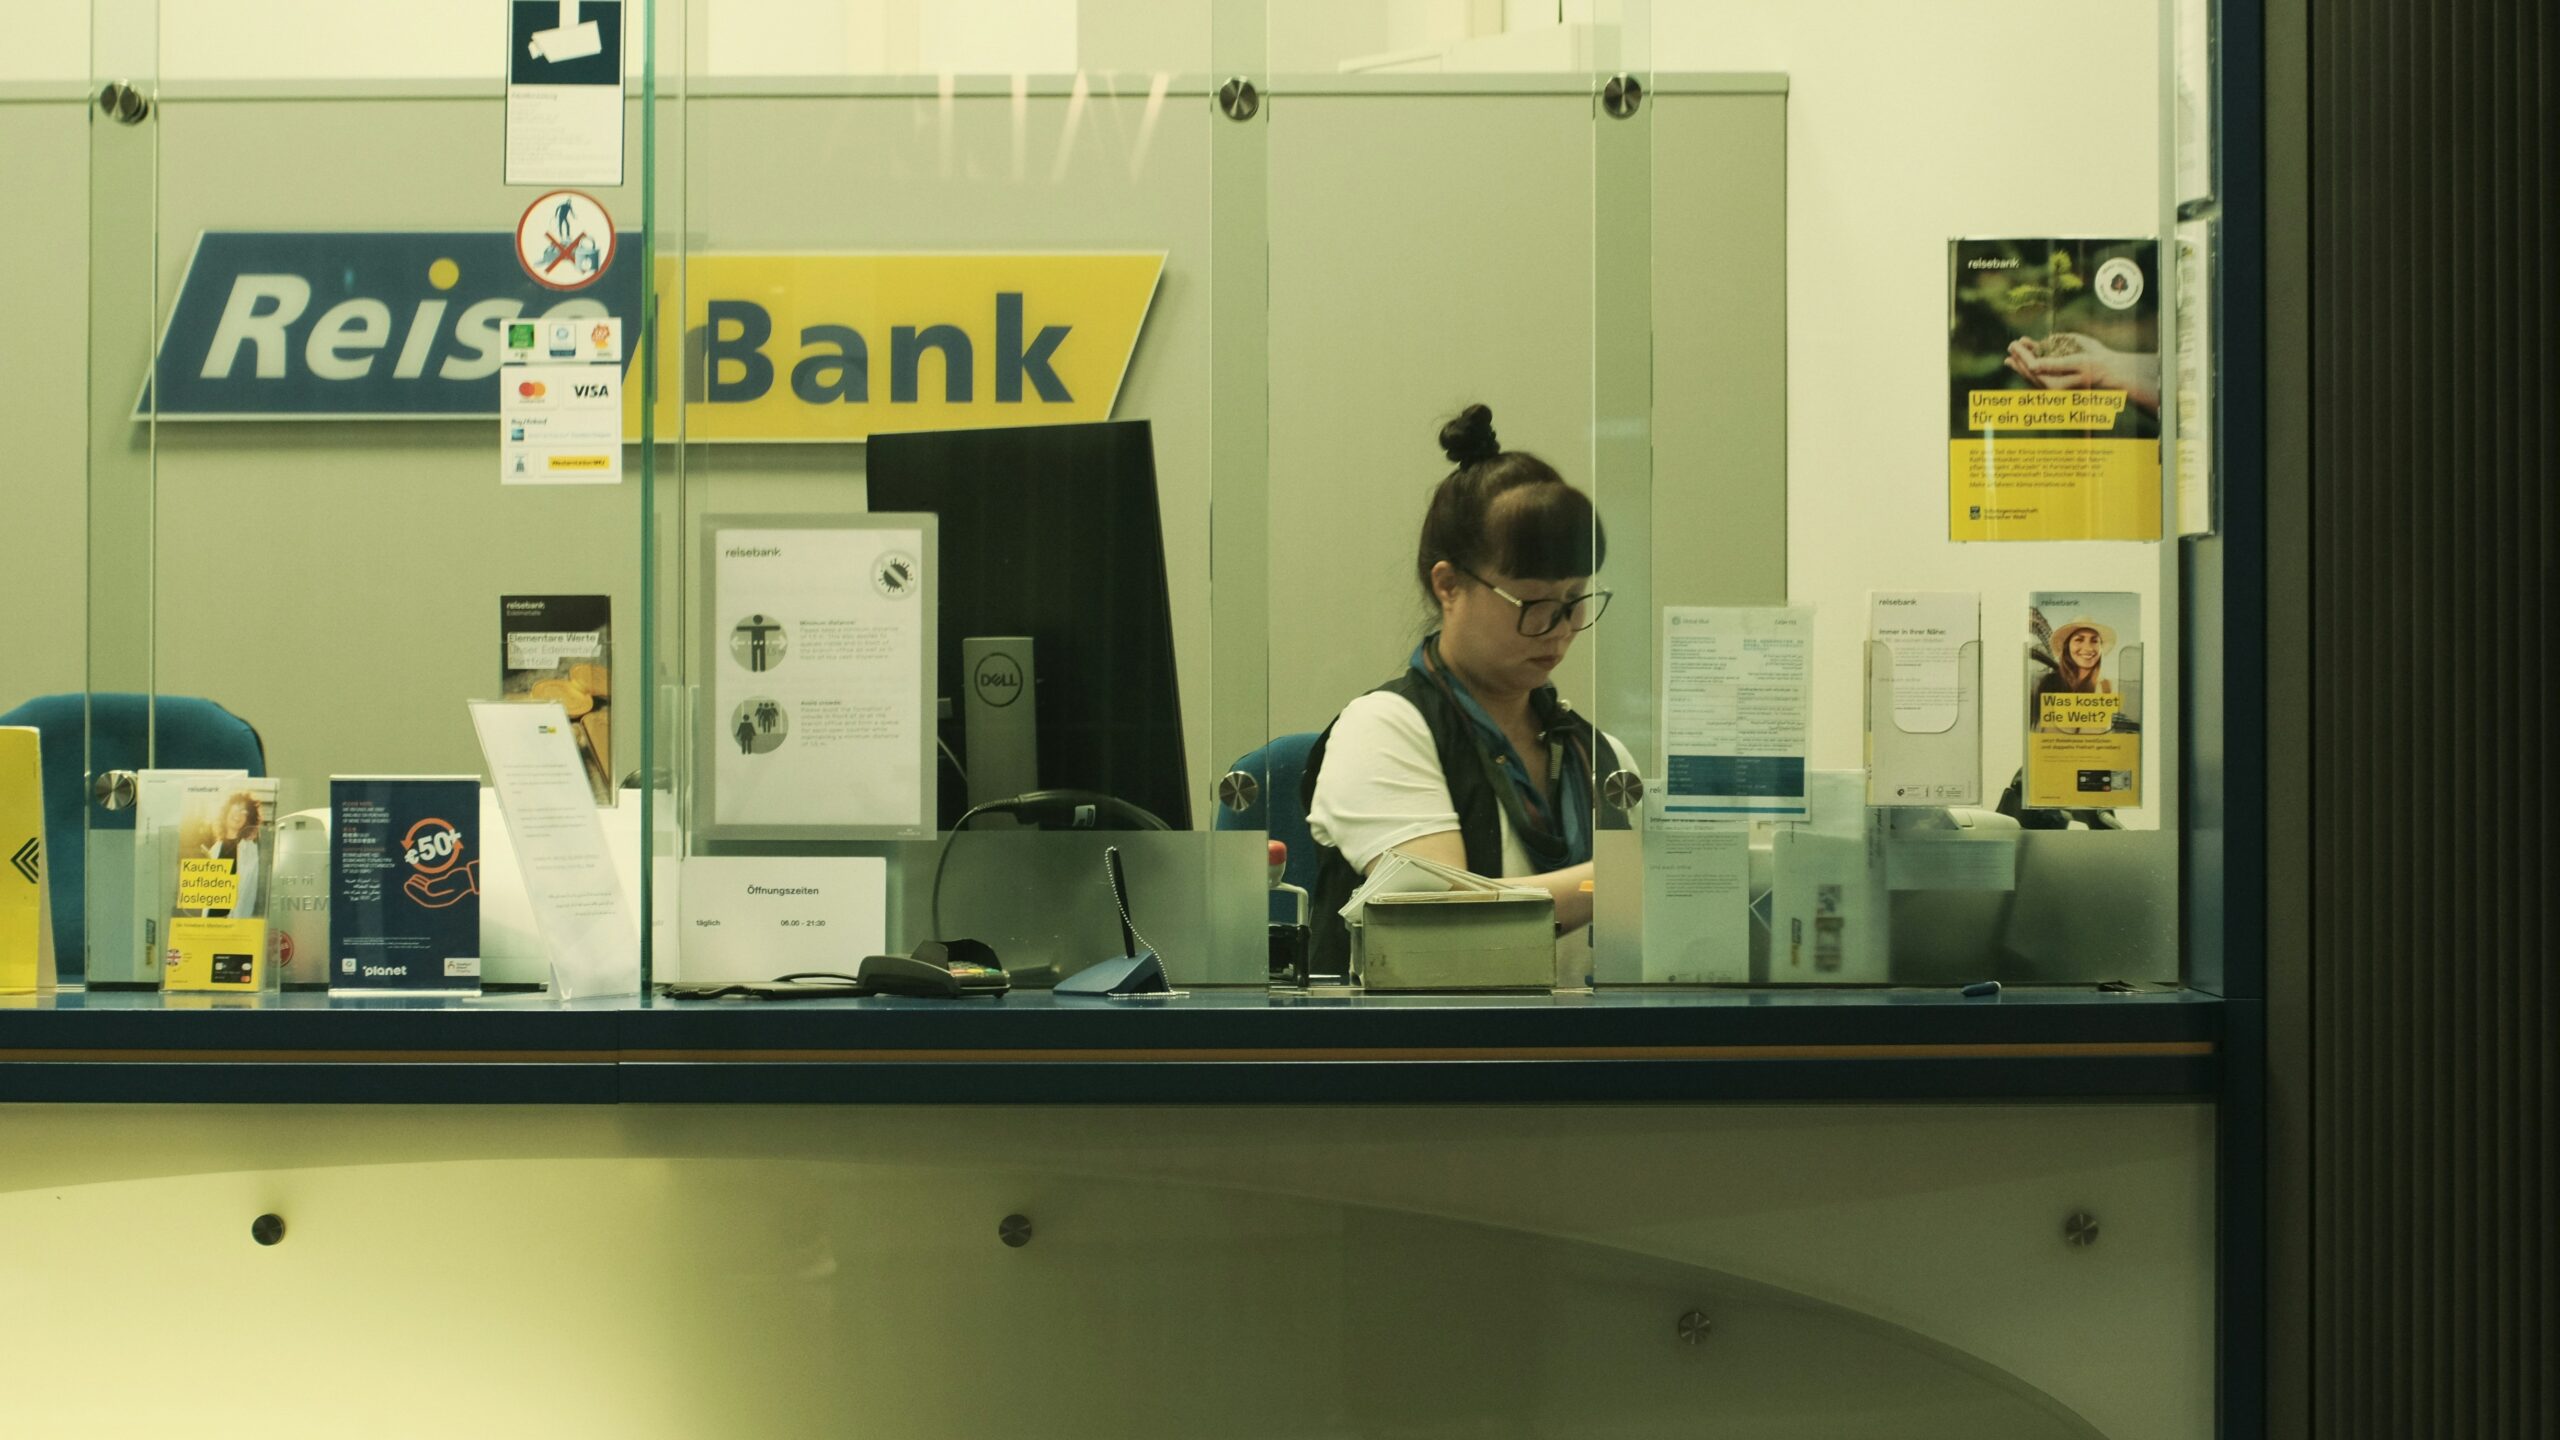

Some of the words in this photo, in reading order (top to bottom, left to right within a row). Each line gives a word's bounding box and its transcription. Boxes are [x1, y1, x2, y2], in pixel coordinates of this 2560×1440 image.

[1967, 257, 2020, 269] reisebank
[200, 258, 611, 380] Reis
[707, 291, 1075, 405] Bank
[574, 385, 609, 398] VISA
[1972, 394, 2013, 406] Unser
[2018, 393, 2067, 406] aktiver
[2072, 393, 2122, 409] Beitrag
[1972, 411, 1993, 424] für
[1998, 411, 2018, 424] ein
[2023, 412, 2064, 426] gutes
[2069, 411, 2111, 424] Klima.
[725, 546, 782, 558] reisebank
[506, 600, 545, 610] reisebank
[1879, 598, 1918, 606] reisebank
[2041, 598, 2080, 606] reisebank
[509, 634, 564, 642] Elementare
[566, 633, 597, 642] Werte
[980, 673, 1018, 687] DELL
[2043, 696, 2072, 707] Was
[2076, 695, 2119, 707] kostet
[2043, 711, 2063, 723] die
[2068, 711, 2106, 723] Welt?
[404, 828, 462, 865] €50+
[183, 861, 227, 873] Kaufen,
[181, 877, 235, 889] aufladen,
[747, 884, 819, 896] Öffnungszeiten
[179, 893, 232, 906] loslegen!
[696, 919, 721, 928] täglich
[806, 919, 826, 927] 21:30
[365, 965, 407, 977] planet
